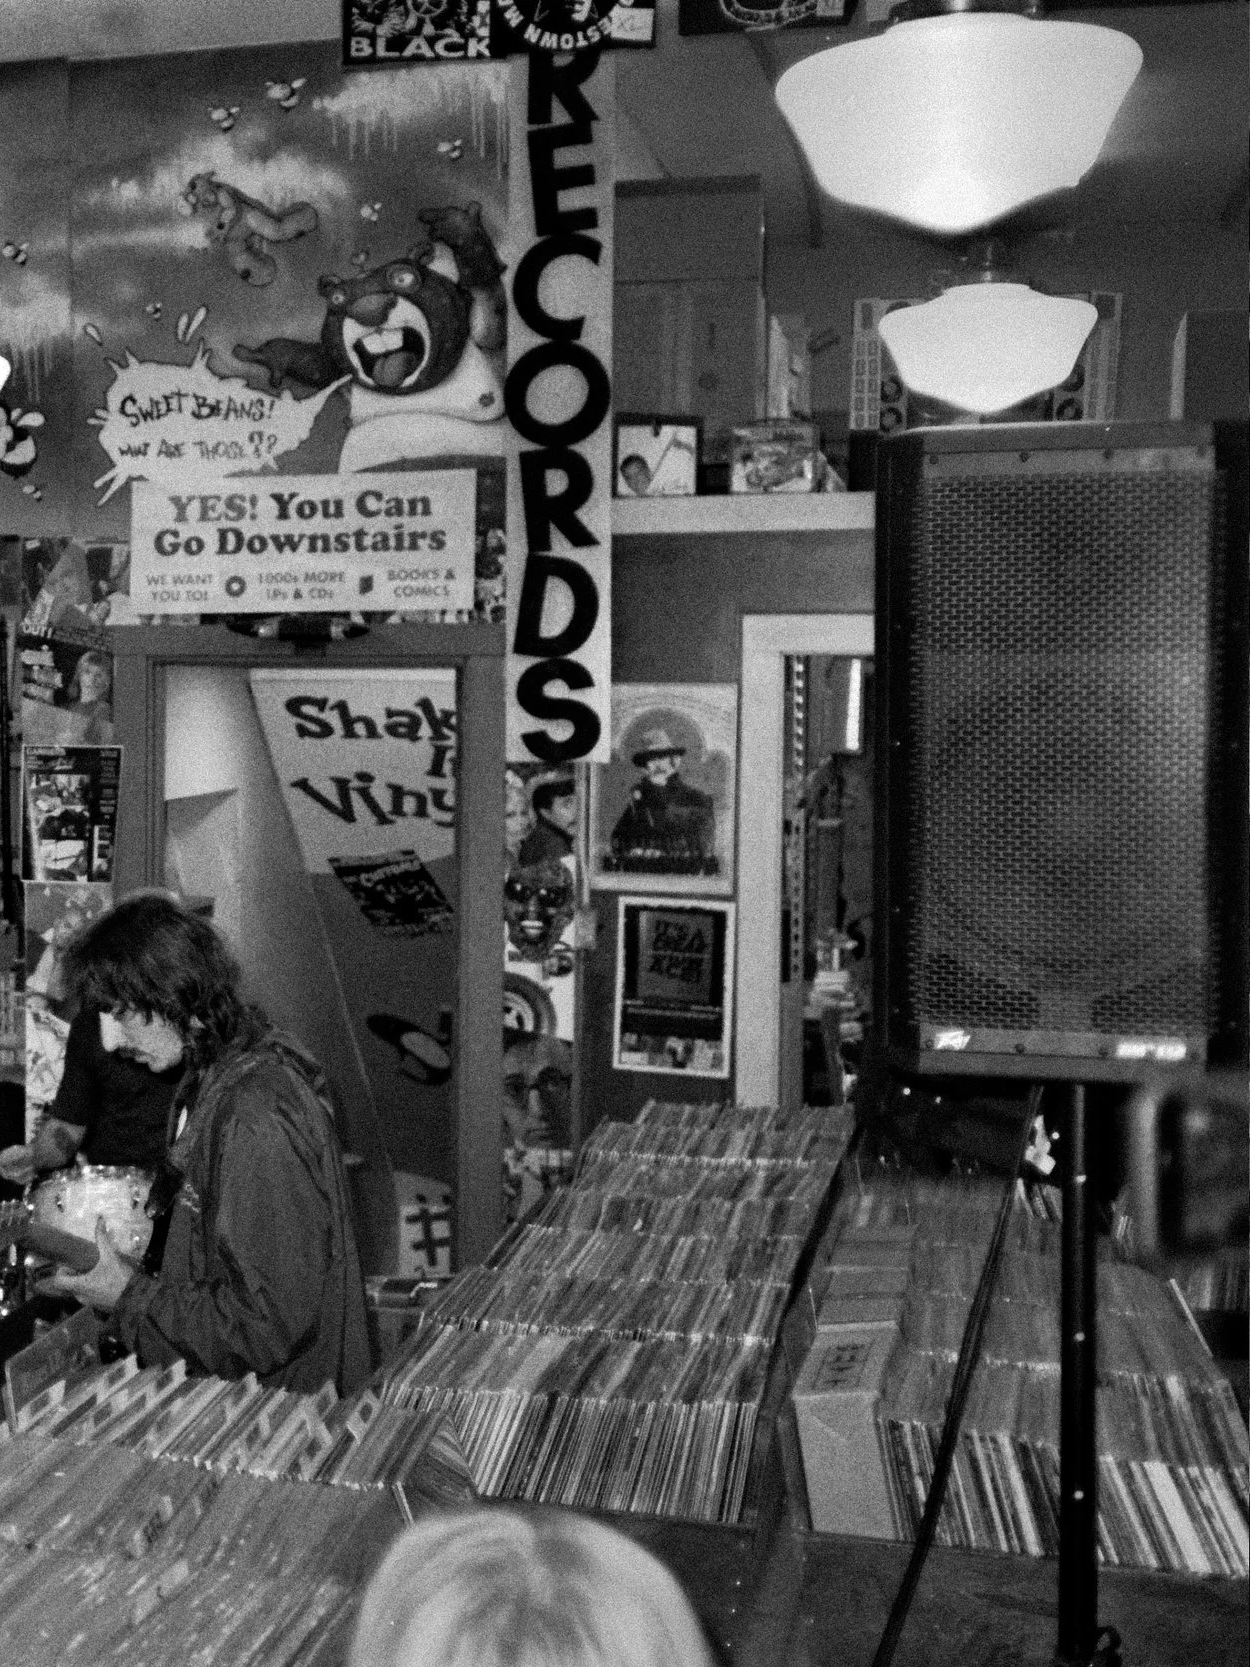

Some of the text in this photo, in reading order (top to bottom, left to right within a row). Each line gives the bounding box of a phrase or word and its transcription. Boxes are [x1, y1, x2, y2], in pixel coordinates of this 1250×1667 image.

[350, 35, 492, 58] BLACK
[120, 389, 275, 427] SWEET BEANS!
[503, 52, 610, 762] RECORDS
[157, 439, 186, 460] ARE
[169, 490, 433, 523] YES! You Can
[154, 524, 447, 557] Go Downstairs
[146, 573, 214, 587] WE WANT
[303, 570, 346, 584] MORE
[387, 568, 456, 582] BOOKS &
[152, 589, 182, 603] YOU
[266, 586, 335, 600] LPs & CDs
[393, 584, 451, 598] COMICS
[285, 695, 457, 742] Shak
[426, 744, 457, 778] I
[290, 771, 457, 828] Viny
